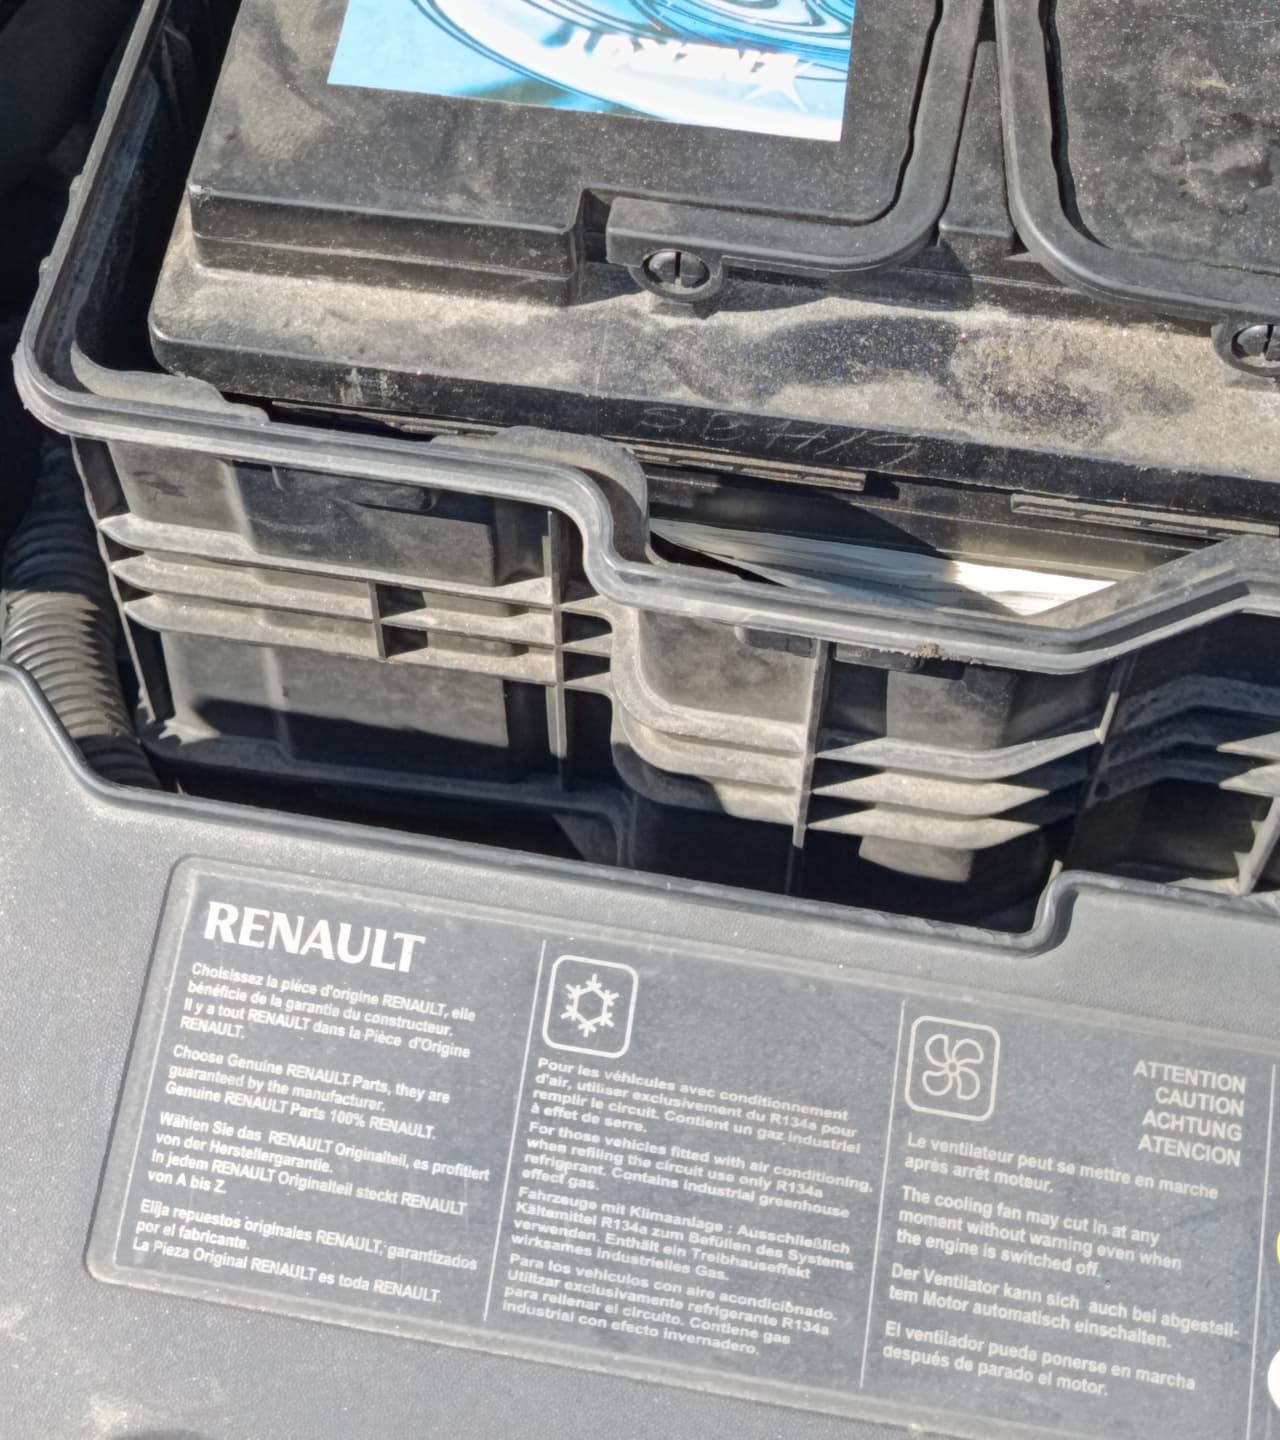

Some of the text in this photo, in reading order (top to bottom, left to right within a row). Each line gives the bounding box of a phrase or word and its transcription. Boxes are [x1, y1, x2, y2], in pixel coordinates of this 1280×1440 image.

[202, 900, 427, 973] RENAULT
[186, 978, 247, 1002] bénéficie
[249, 990, 267, 1005] de
[269, 992, 282, 1008] la
[342, 1006, 361, 1021] du
[363, 1011, 454, 1037] constructeur.
[190, 960, 264, 986] Choisissez
[264, 973, 279, 989] la
[450, 1005, 476, 1022] elle
[182, 996, 471, 1059] Il y a tout RENAULT dans la Pièce d'Origine
[166, 1064, 386, 1112] guaranteed by the manufacturer.
[171, 1042, 224, 1065] Choose
[226, 1052, 284, 1075] Genuine
[284, 1062, 352, 1086] RENAULT
[394, 1081, 426, 1102] they
[426, 1089, 451, 1105] are
[536, 1056, 575, 1074] Pour
[576, 1063, 600, 1078] les
[678, 1083, 716, 1098] avec
[718, 1090, 849, 1122] conditionnement
[1132, 1058, 1247, 1094] ATTENTION
[1154, 1085, 1245, 1118] CAUTION
[164, 1079, 222, 1103] Genuine
[222, 1089, 289, 1114] RENAULT
[288, 1100, 326, 1121] Parts
[329, 1108, 366, 1128] 100%
[531, 1088, 588, 1107] remplir
[589, 1096, 604, 1110] le
[662, 1109, 730, 1132] Contient
[731, 1123, 753, 1136] un
[755, 1127, 784, 1141] gaz
[786, 1130, 861, 1154] industriel
[533, 1071, 572, 1090] d'air,
[631, 1090, 742, 1118] exclusivement
[744, 1108, 766, 1122] du
[768, 1111, 817, 1131] R134a
[820, 1123, 858, 1138] pour
[542, 1105, 578, 1121] effet
[579, 1111, 601, 1125] de
[603, 1116, 647, 1133] serre.
[1140, 1108, 1243, 1142] ACHTUNG
[154, 1132, 333, 1173] von der Herstellergarantie.
[158, 1110, 210, 1132] Wählen
[210, 1119, 235, 1137] Sie
[235, 1124, 262, 1142] das
[267, 1129, 334, 1154] RENAULT
[411, 1158, 430, 1171] es
[430, 1161, 491, 1182] profitiert
[527, 1119, 556, 1136] For
[557, 1126, 601, 1143] those
[603, 1135, 667, 1156] vehicles
[669, 1144, 710, 1163] fitted
[712, 1154, 746, 1169] with
[748, 1160, 770, 1173] air
[903, 1155, 949, 1175] après
[992, 1170, 1054, 1194] moteur.
[905, 1130, 1219, 1200] Le ventilateur peut se mettre en marche
[1136, 1132, 1241, 1168] ATENCION
[897, 1208, 1183, 1271] moment without warning even when
[900, 1183, 931, 1205] The
[932, 1193, 993, 1219] cooling
[995, 1200, 1022, 1221] fan
[1024, 1209, 1060, 1230] may
[1061, 1216, 1090, 1232] cut
[1110, 1224, 1128, 1239] at
[1129, 1228, 1160, 1248] any
[895, 1227, 1101, 1278] the engine is switched off.
